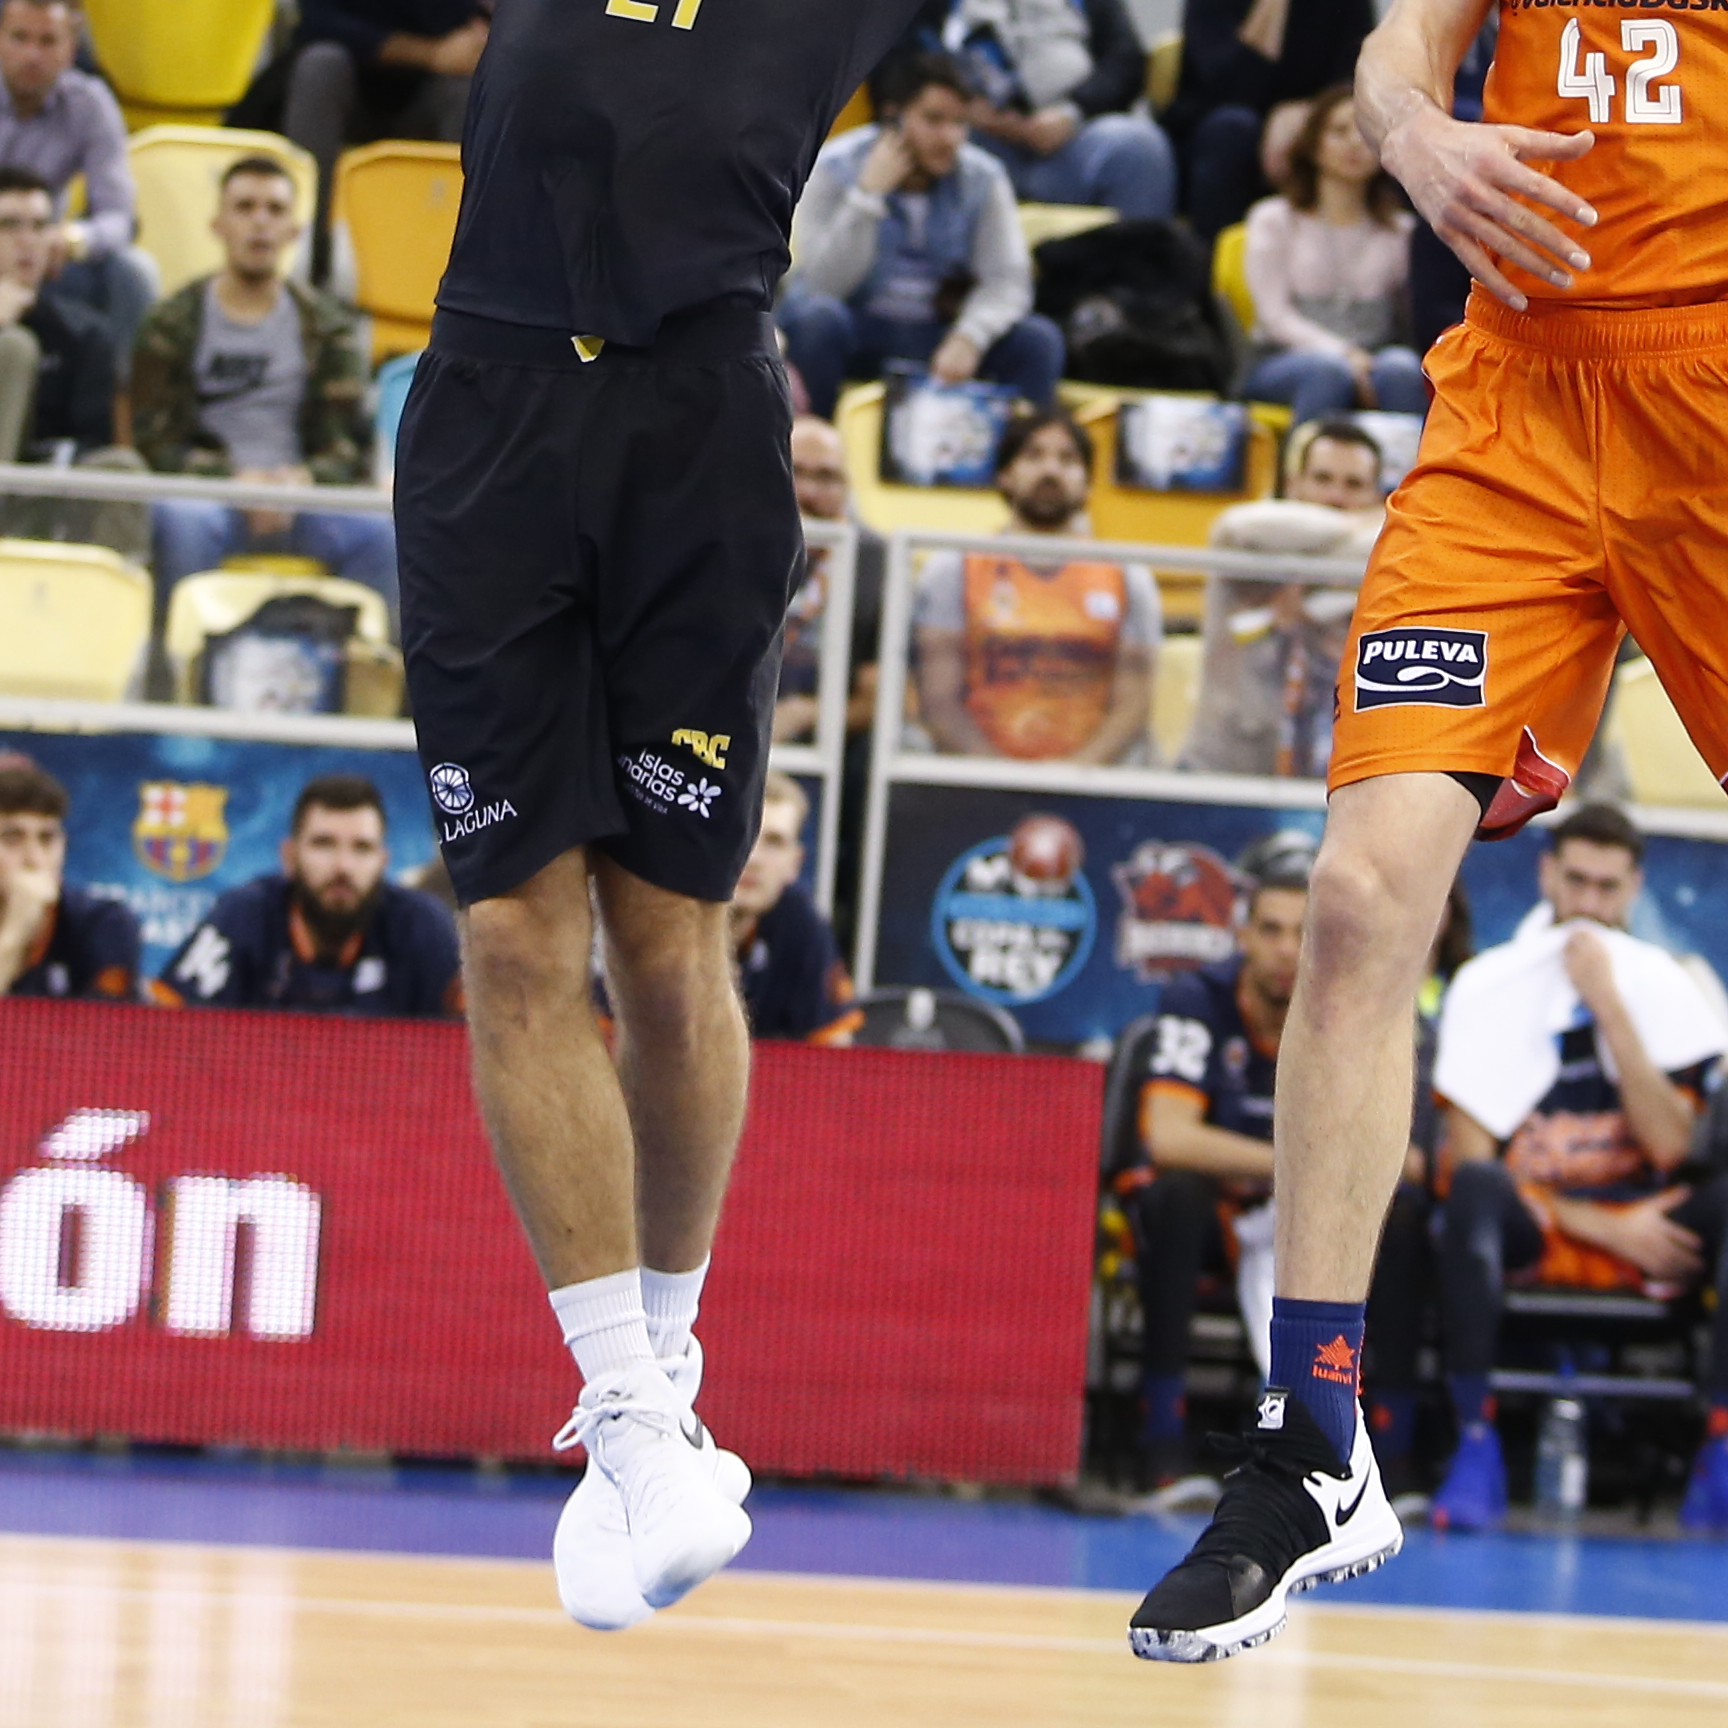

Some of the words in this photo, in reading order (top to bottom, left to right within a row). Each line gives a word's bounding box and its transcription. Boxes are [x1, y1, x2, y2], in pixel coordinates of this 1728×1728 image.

[1557, 17, 1683, 124] 42
[1362, 640, 1479, 665] PULEVA
[616, 753, 678, 802] narias
[443, 799, 518, 842] LAGUNA
[969, 943, 1062, 1000] REY
